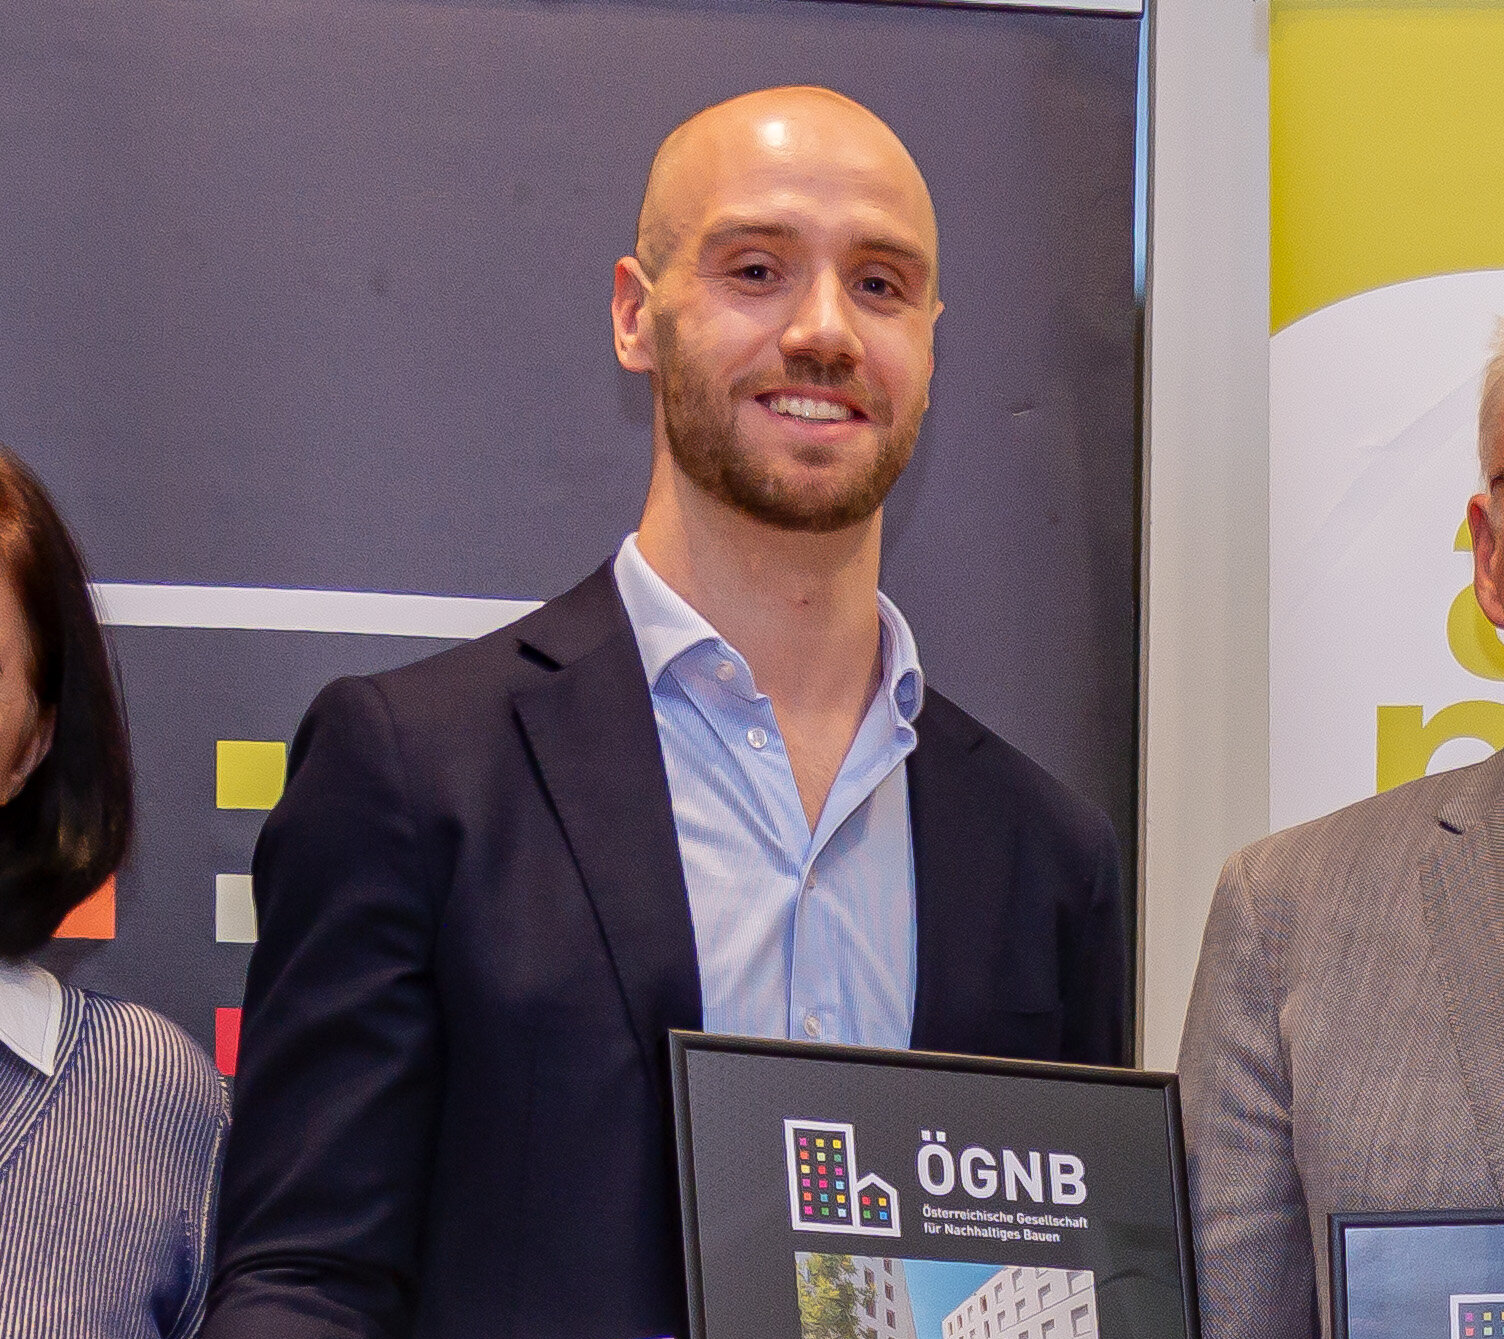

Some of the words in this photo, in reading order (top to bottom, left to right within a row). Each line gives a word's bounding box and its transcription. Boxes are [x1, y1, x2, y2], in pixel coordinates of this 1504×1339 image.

[916, 1129, 1087, 1205] ÖGNB
[922, 1203, 1014, 1224] Österreichische
[1016, 1213, 1088, 1229] Gesellschaft
[923, 1222, 942, 1235] für
[944, 1223, 1021, 1242] Nachhaltiges
[1023, 1229, 1061, 1243] Bauen
